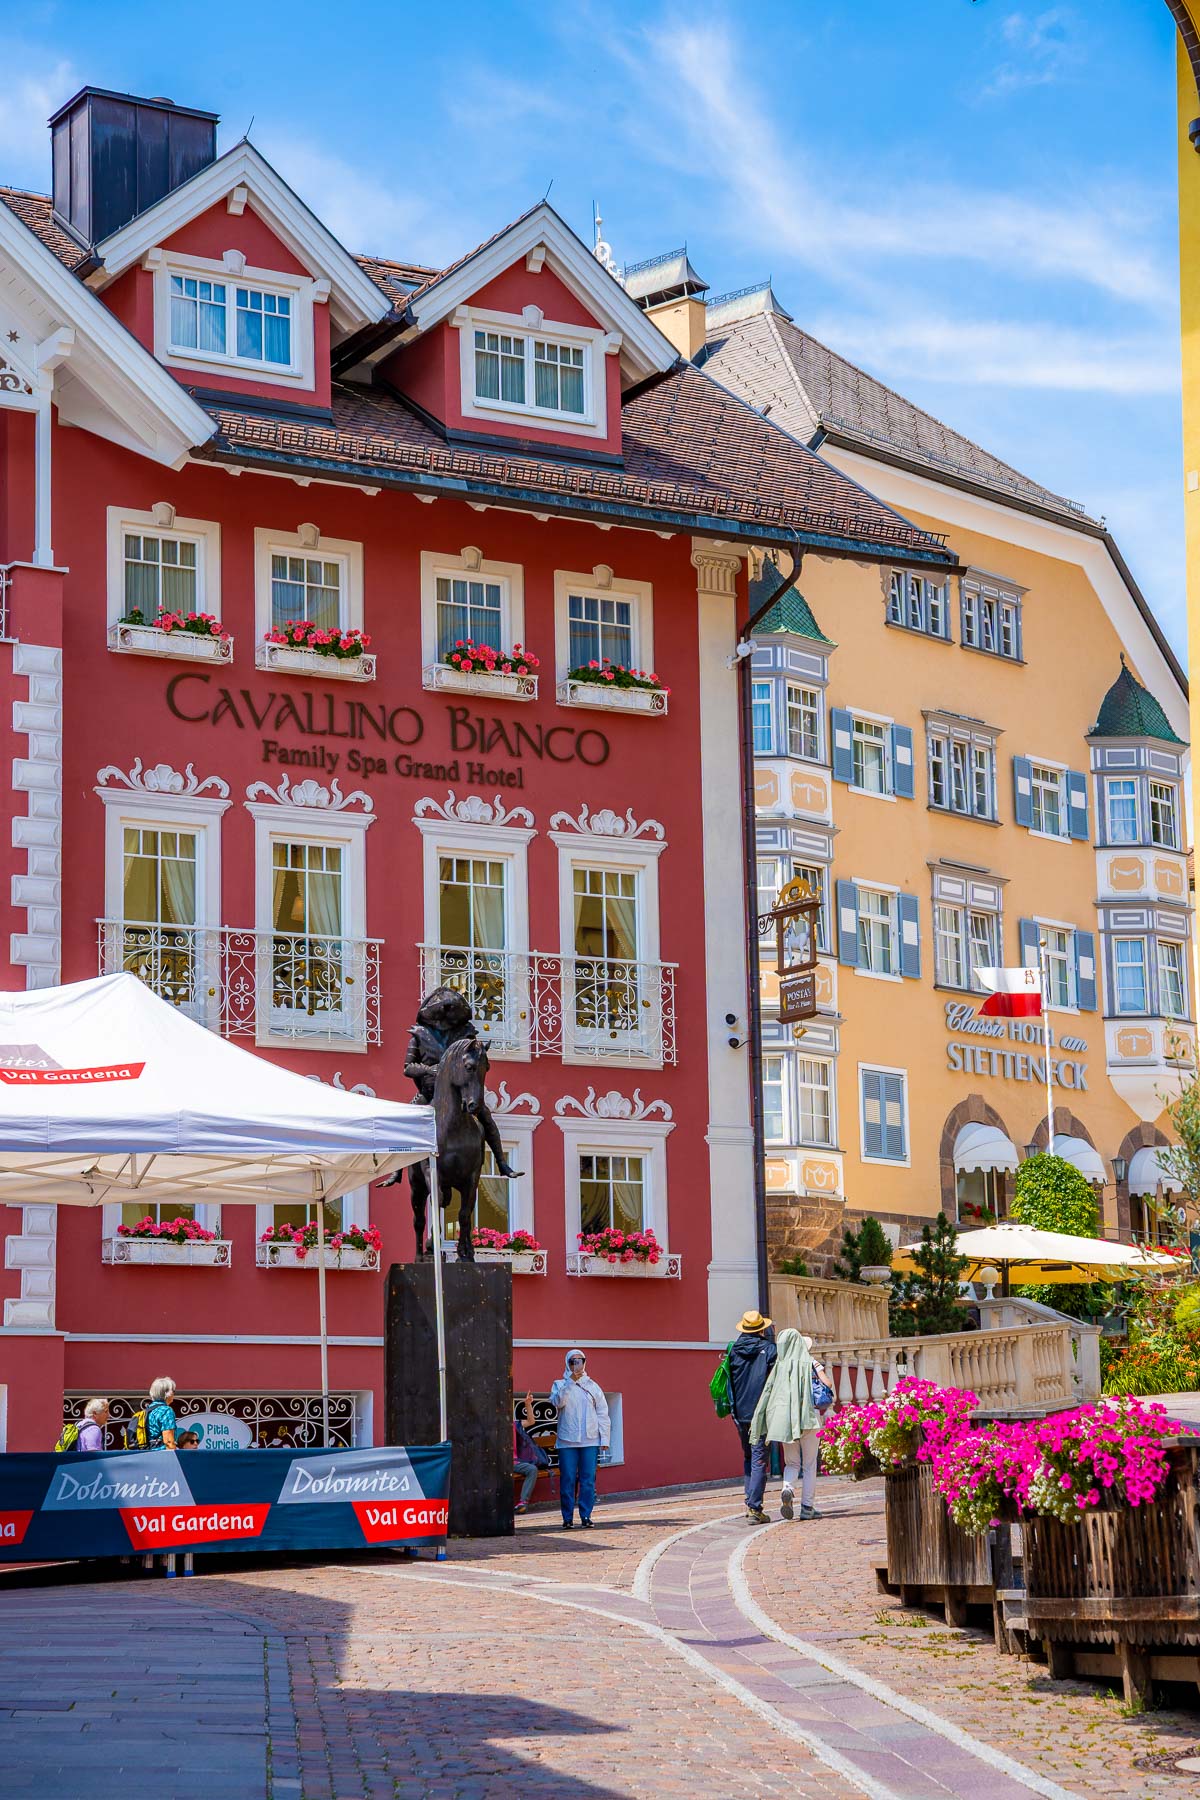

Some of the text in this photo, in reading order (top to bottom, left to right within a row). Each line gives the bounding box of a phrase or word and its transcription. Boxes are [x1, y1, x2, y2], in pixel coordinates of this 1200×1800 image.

[166, 672, 611, 766] CAVALLINO BIANCO
[262, 739, 524, 789] Family Spa Grand Hotel
[945, 1001, 1007, 1039] Classic
[2, 1070, 131, 1080] Val Gardena
[947, 1042, 1088, 1091] STETTENECK
[206, 1423, 239, 1450] Pitla Suricia
[56, 1472, 180, 1501] Dolomites
[292, 1466, 411, 1494] Dolomites
[133, 1512, 254, 1533] Val Gardena
[366, 1507, 398, 1526] Val
